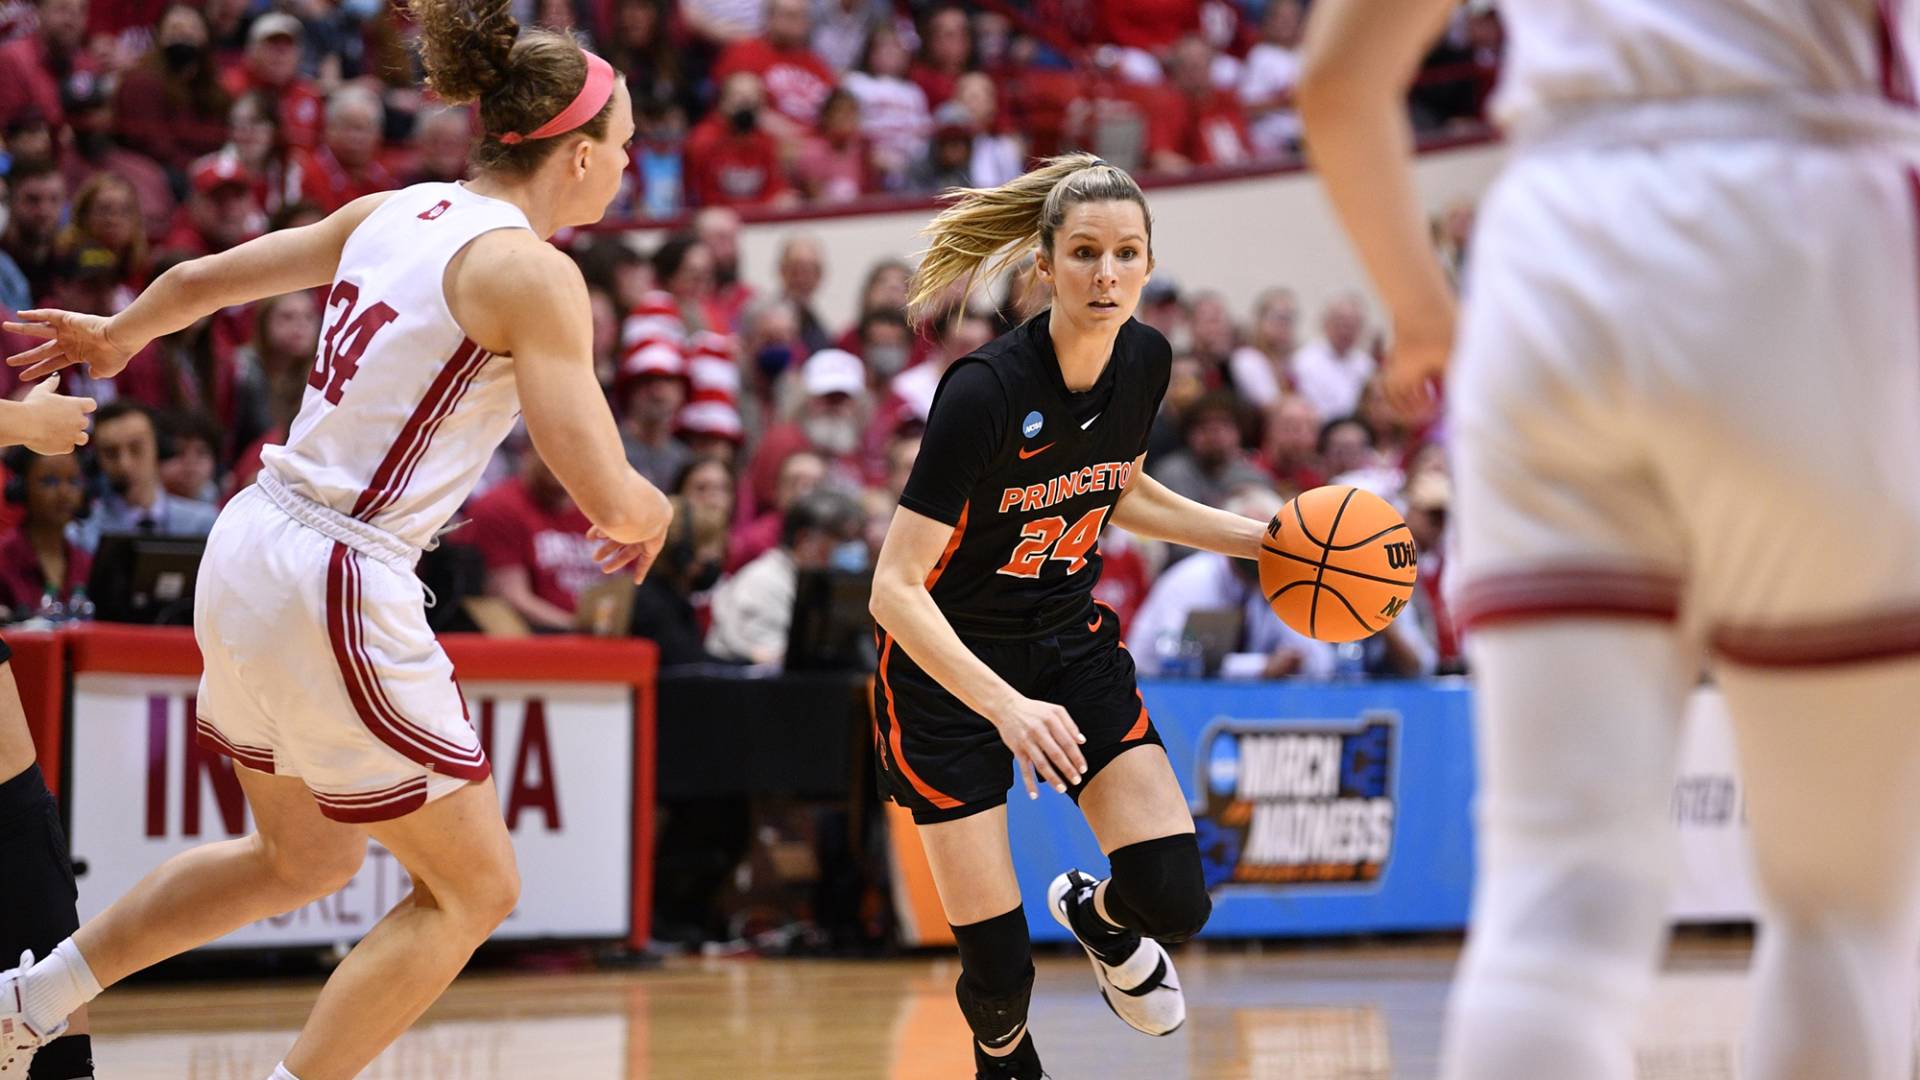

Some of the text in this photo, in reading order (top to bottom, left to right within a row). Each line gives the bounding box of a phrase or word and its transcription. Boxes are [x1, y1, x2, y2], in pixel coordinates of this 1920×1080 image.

[308, 280, 400, 407] 34
[998, 460, 1137, 514] PRINCETO
[995, 504, 1112, 579] 24
[1383, 539, 1418, 570] Wil
